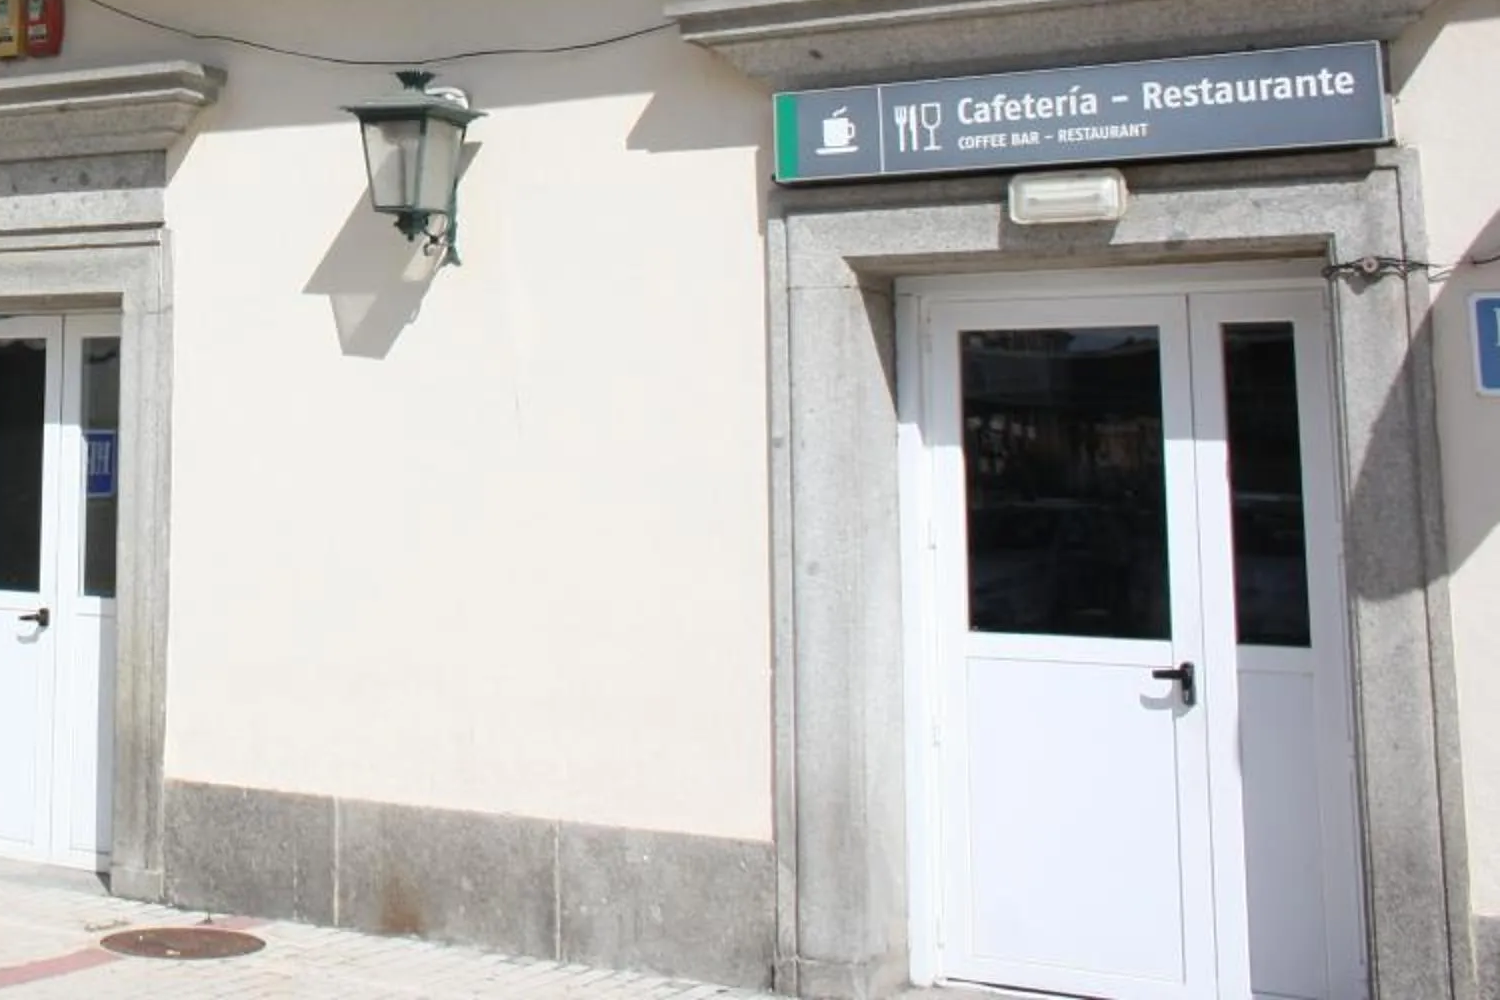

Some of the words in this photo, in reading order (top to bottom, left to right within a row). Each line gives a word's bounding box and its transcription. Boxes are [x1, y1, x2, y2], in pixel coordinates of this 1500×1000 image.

[957, 85, 1097, 125] Cafetería
[1142, 67, 1355, 111] Restaurante
[958, 132, 1008, 150] COFFEE
[1011, 131, 1041, 147] BAR
[1057, 123, 1149, 144] RESTAURANT
